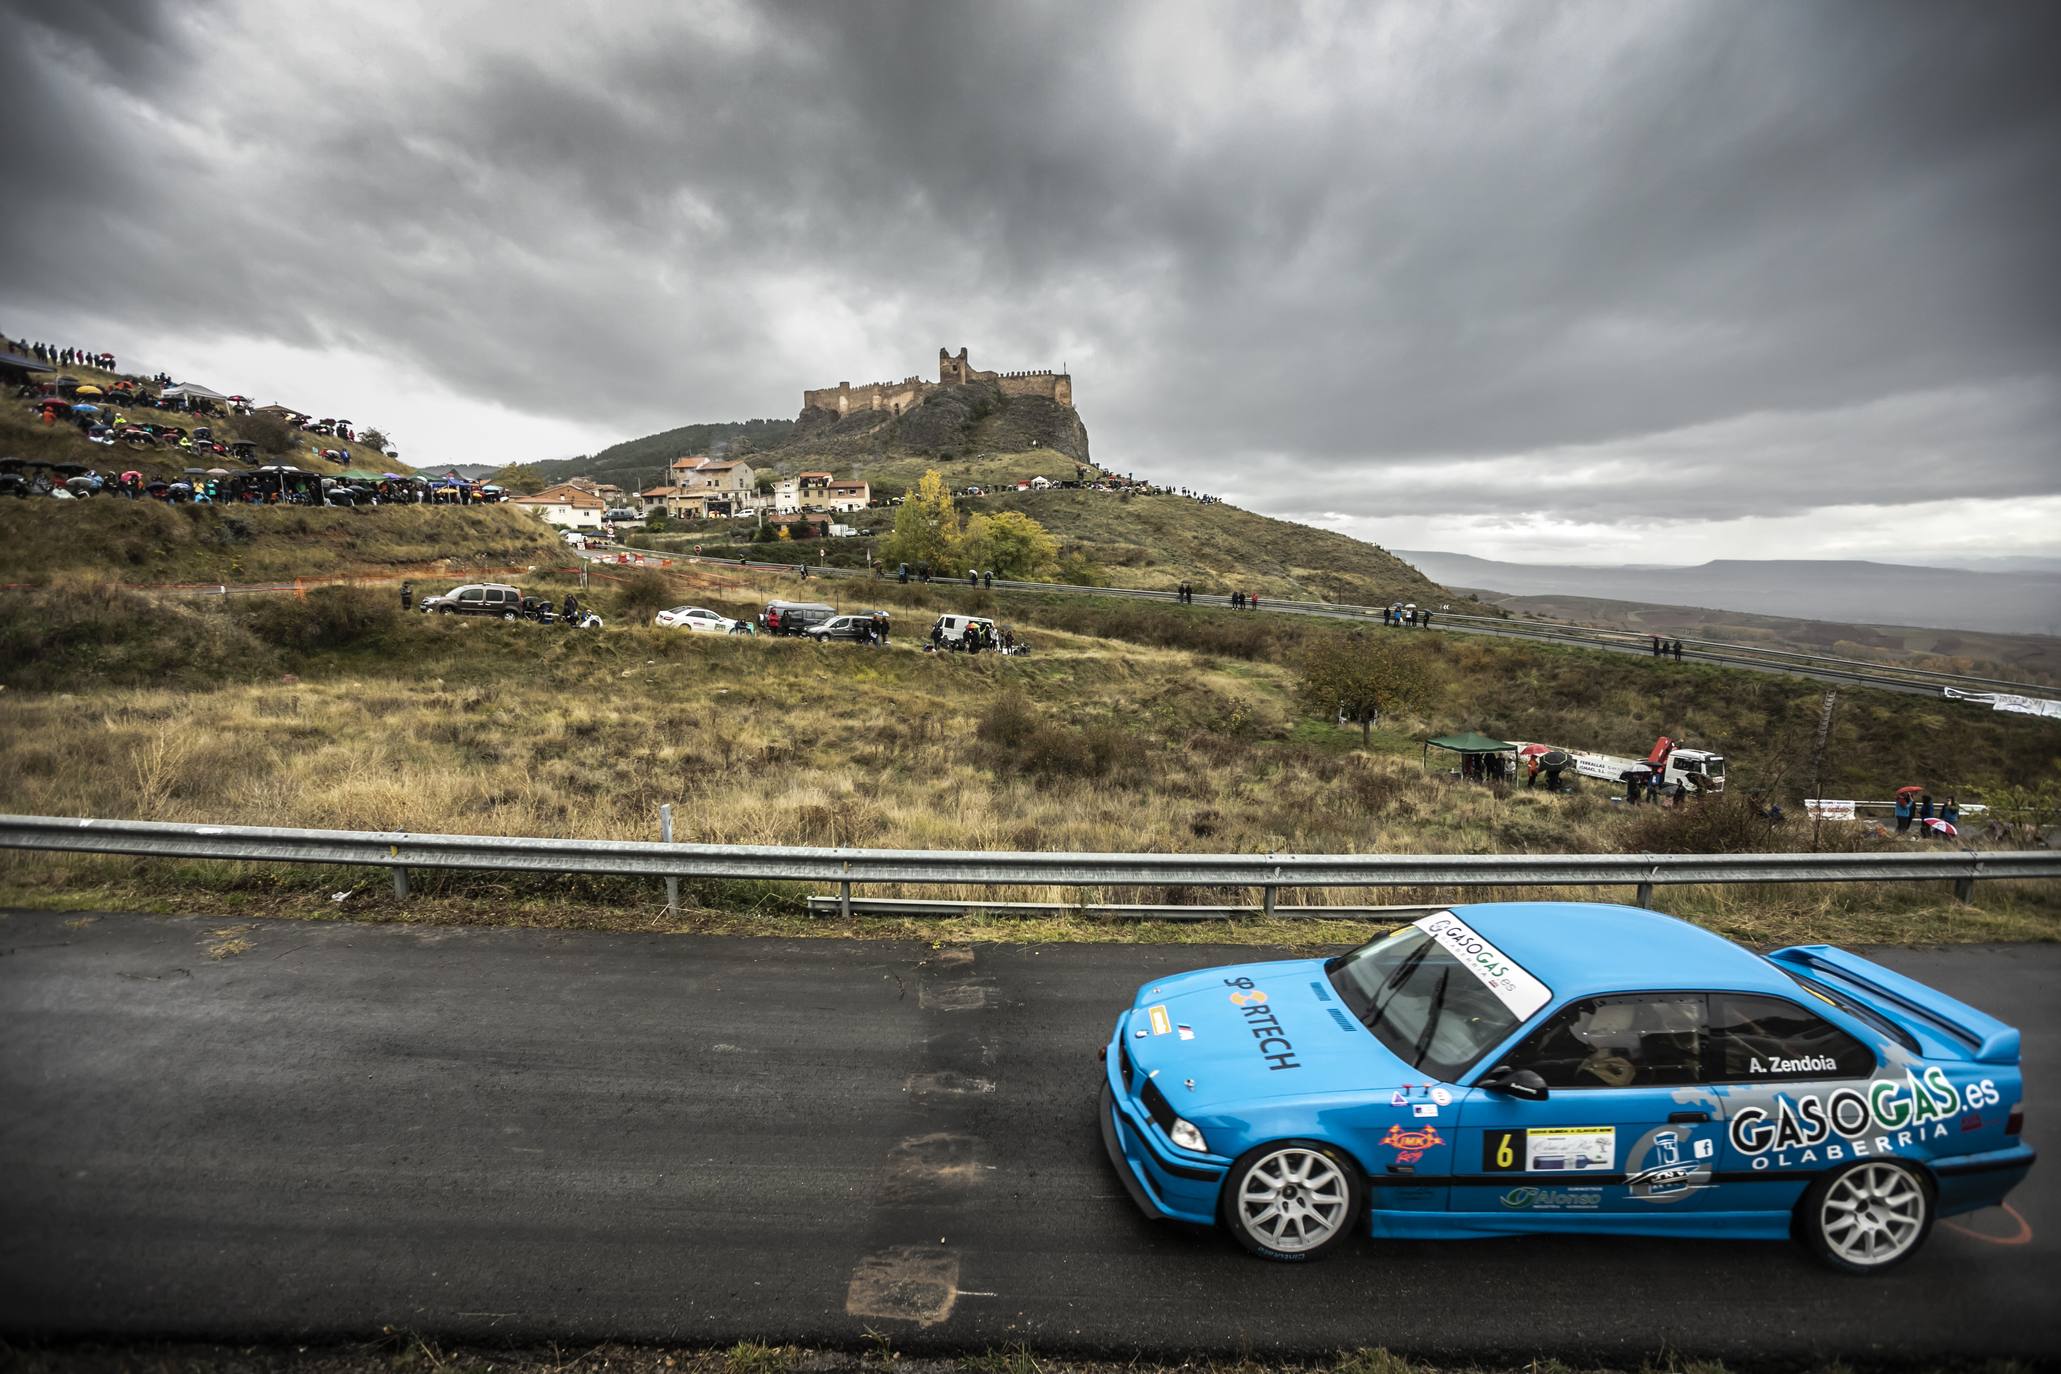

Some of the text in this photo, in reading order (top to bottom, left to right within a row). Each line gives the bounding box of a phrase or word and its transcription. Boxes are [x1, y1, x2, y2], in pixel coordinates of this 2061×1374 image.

[1749, 1055, 1837, 1073] A. Zendoia
[1497, 1133, 1513, 1168] 6
[1752, 1124, 1948, 1170] OLABERRIA
